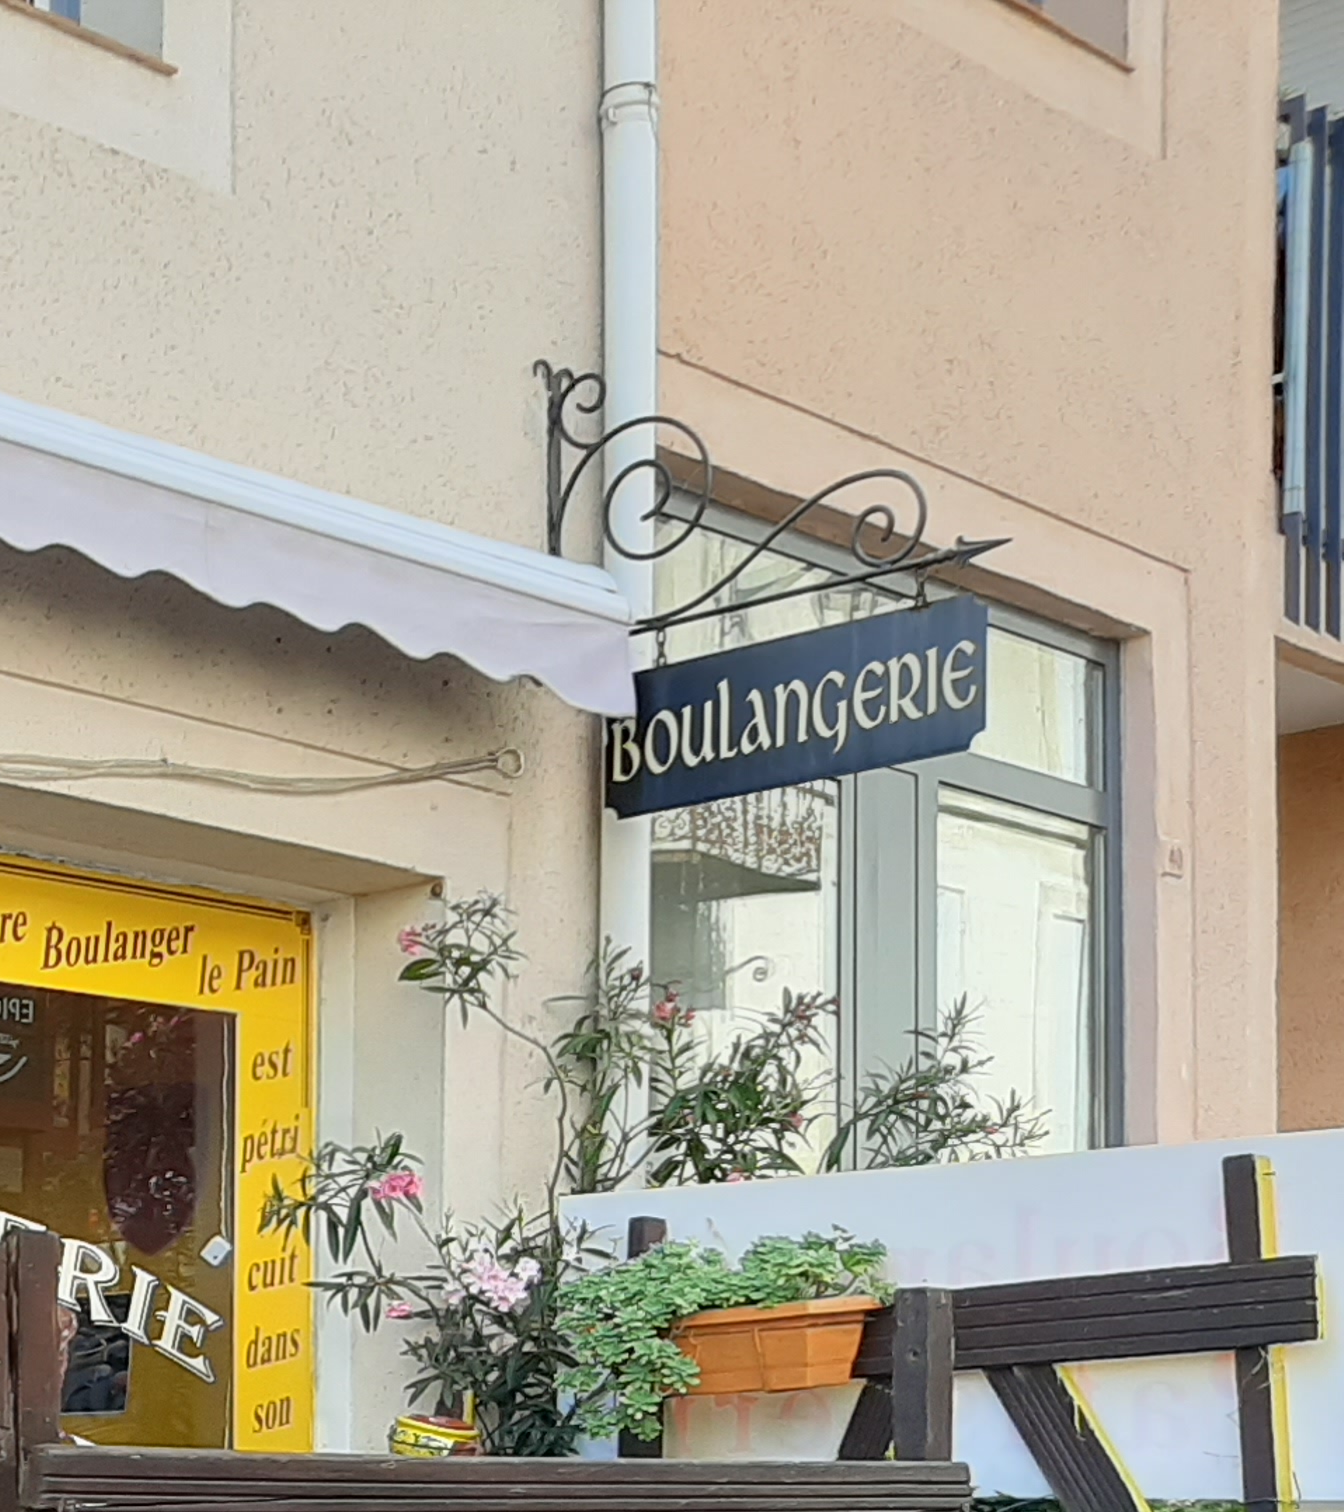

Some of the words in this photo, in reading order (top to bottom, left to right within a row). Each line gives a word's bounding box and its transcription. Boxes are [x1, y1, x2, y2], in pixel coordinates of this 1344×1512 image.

[611, 638, 977, 783] BOULANGERIE
[40, 919, 196, 970] Boulanger
[198, 953, 223, 996] le
[234, 946, 297, 991] Pain
[250, 1039, 293, 1082] est
[239, 1113, 301, 1174] pétri
[247, 1246, 299, 1294] cuit
[245, 1324, 302, 1370] dans
[252, 1393, 293, 1434] son
